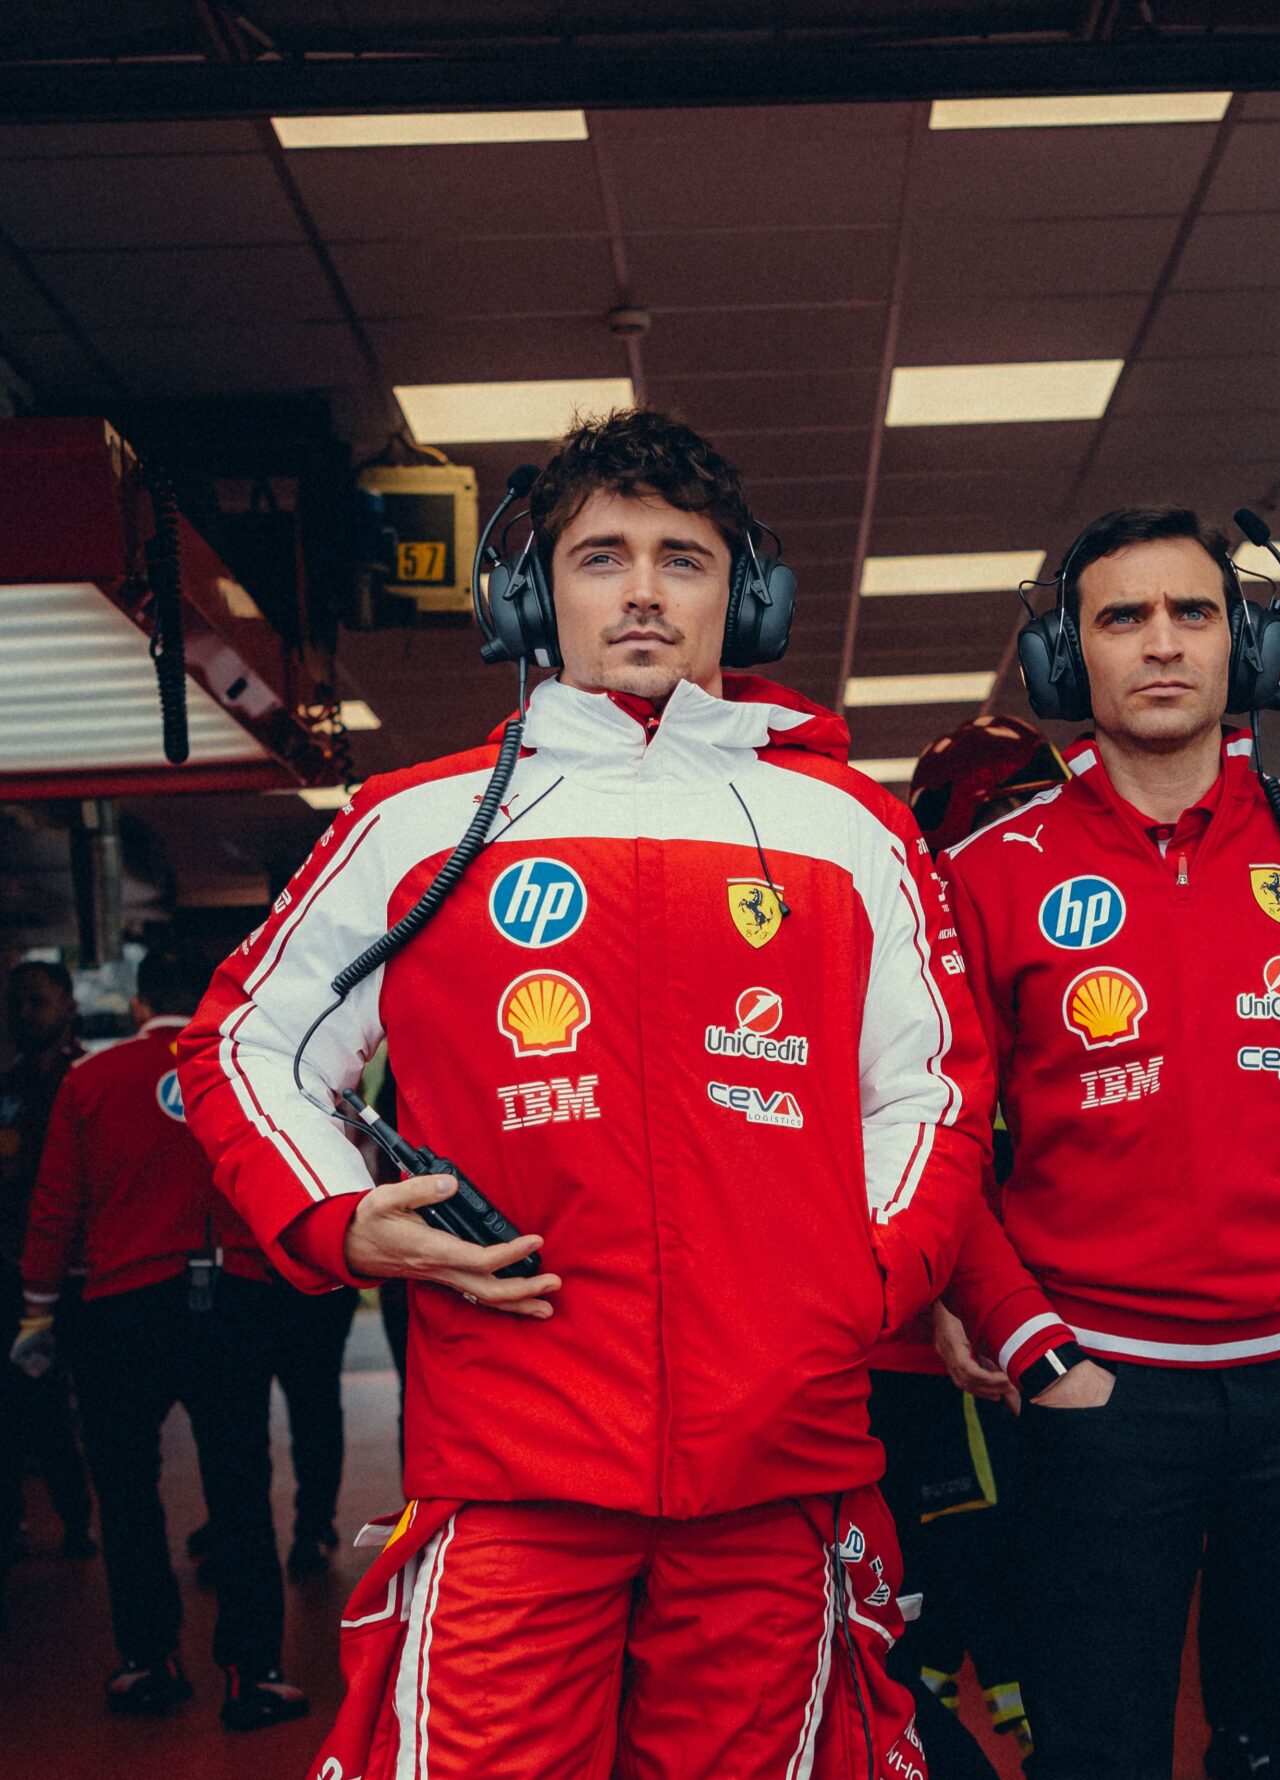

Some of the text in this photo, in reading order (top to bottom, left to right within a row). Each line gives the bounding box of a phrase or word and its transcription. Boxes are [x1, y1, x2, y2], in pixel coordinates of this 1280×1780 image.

[403, 545, 438, 577] 57
[504, 860, 574, 945] hp
[1055, 881, 1111, 947] hp
[706, 1026, 807, 1064] UniCredit
[497, 1074, 600, 1131] IBM
[1080, 1056, 1164, 1109] IBM
[748, 1113, 802, 1127] LOGISTICS
